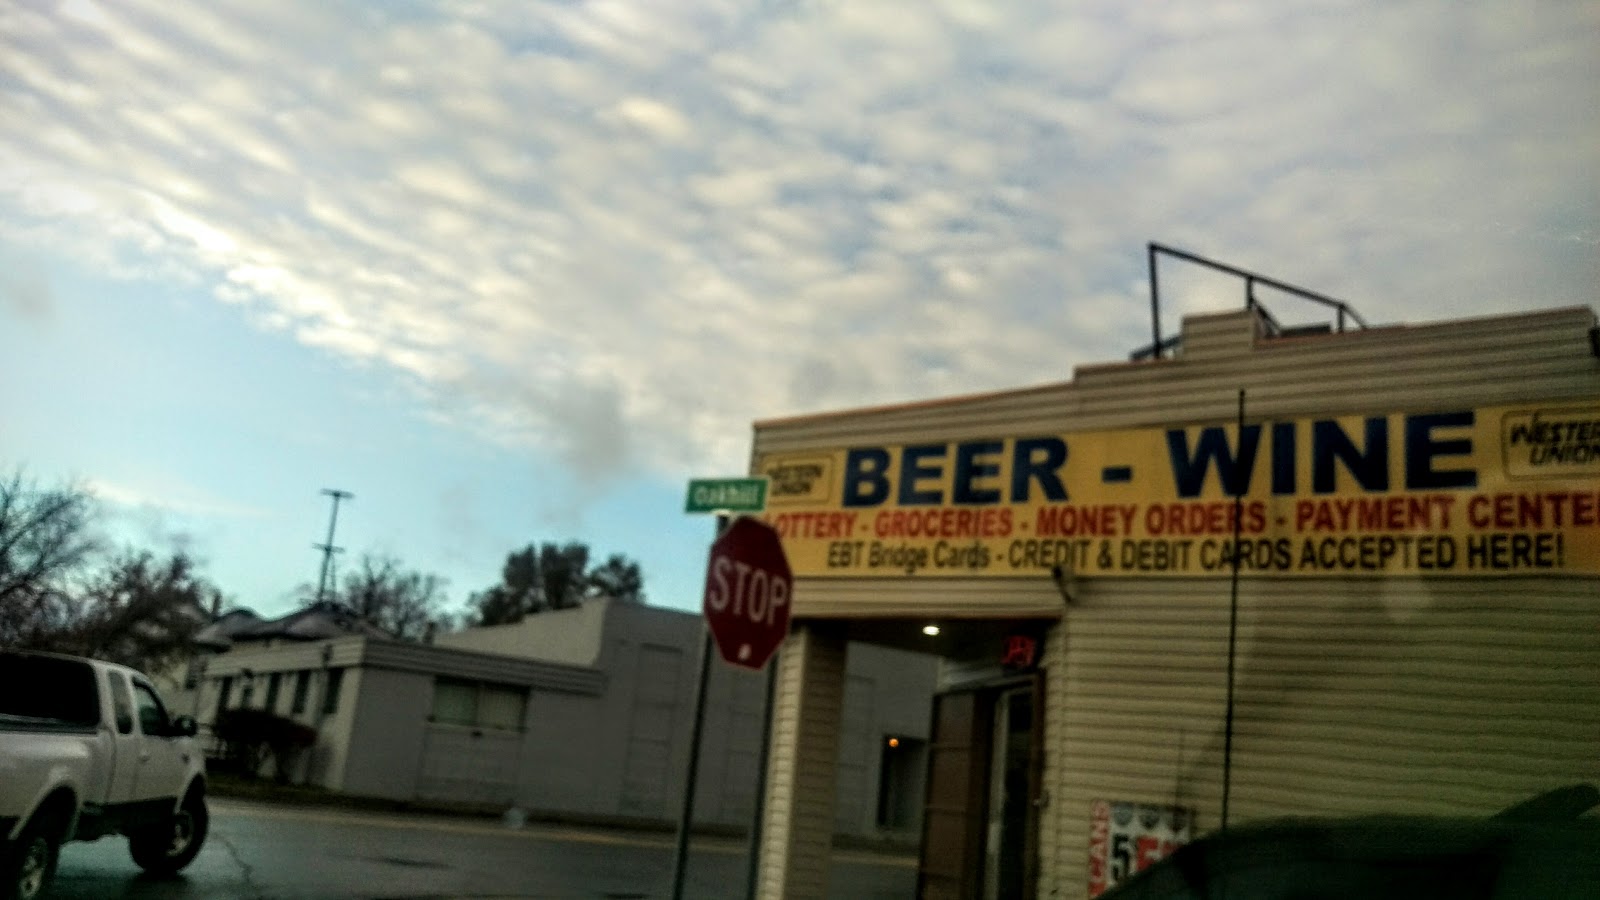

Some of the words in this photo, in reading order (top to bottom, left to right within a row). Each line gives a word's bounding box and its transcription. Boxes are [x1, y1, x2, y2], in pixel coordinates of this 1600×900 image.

[843, 438, 1069, 506] BEER
[1102, 466, 1131, 482] -
[1166, 411, 1477, 498] WINE
[764, 512, 857, 539] OTTERY
[874, 508, 1013, 538] GROCERIES
[1035, 504, 1137, 537] MONEY
[1144, 502, 1267, 535] ORDERS
[1296, 496, 1455, 532] PAYMENT
[1467, 490, 1600, 529] CENTE
[827, 540, 864, 569] EBT
[868, 540, 927, 574] Bridge
[932, 539, 990, 569] Cards
[1008, 539, 1090, 569] CREDIT
[1097, 540, 1112, 570] &
[1121, 539, 1195, 571] DEBIT
[1200, 537, 1293, 570] CARDS
[1300, 534, 1456, 571] ACCEPTED
[1465, 532, 1565, 569] HERE!
[709, 556, 788, 626] STOP
